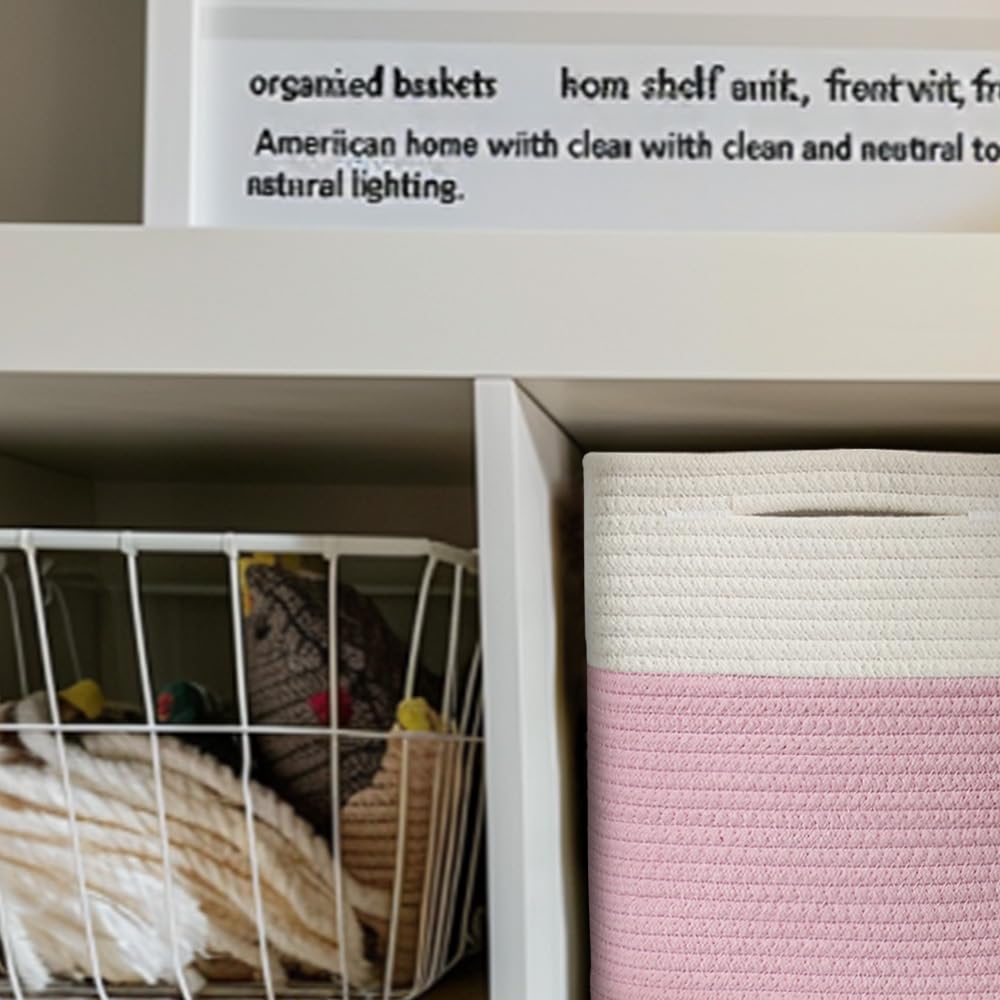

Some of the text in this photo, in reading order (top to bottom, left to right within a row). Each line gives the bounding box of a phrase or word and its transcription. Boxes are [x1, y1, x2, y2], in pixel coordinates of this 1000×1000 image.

[405, 128, 479, 157] home
[801, 132, 852, 162] and
[351, 168, 466, 204] lighting.
